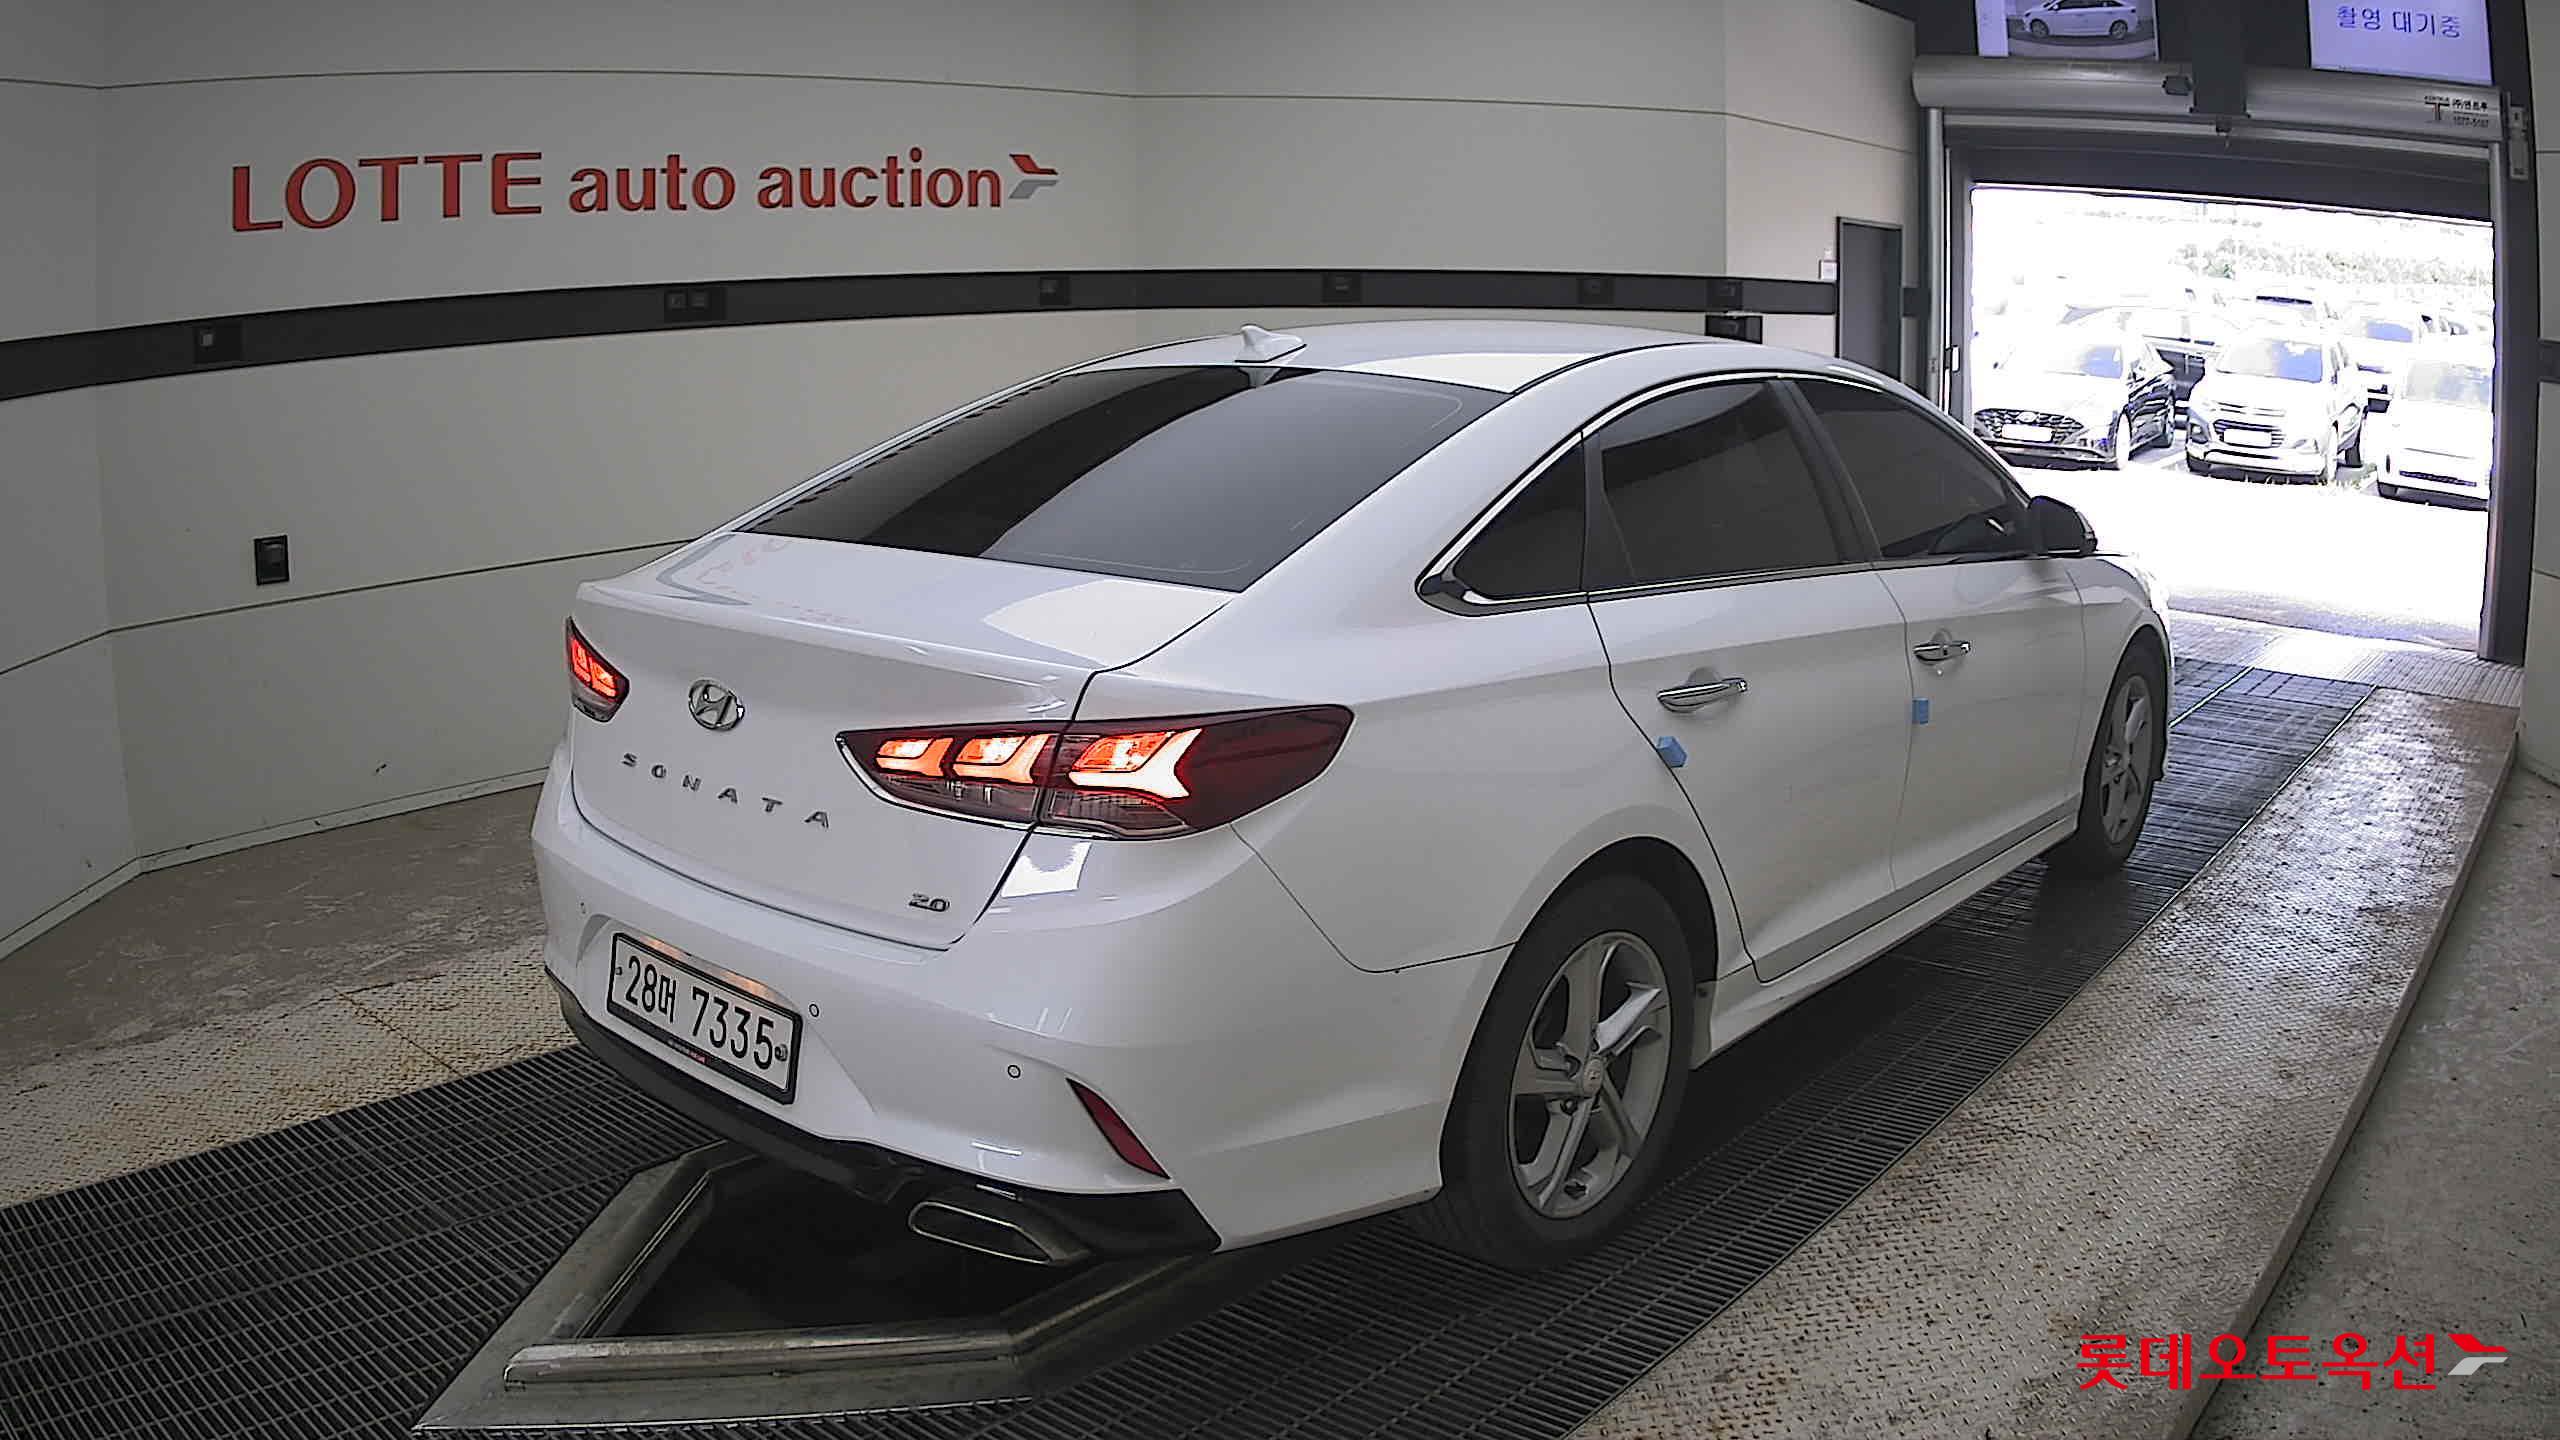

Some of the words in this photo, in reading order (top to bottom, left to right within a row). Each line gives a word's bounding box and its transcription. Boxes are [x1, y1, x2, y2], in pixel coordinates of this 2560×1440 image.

[2337, 5, 2382, 31] 촬영
[2392, 11, 2461, 39] 대기중
[231, 151, 543, 233] LOTTE
[568, 153, 736, 214] auto
[757, 146, 1003, 210] auction
[621, 751, 831, 830] SONATA
[625, 955, 677, 1024] 28머
[692, 985, 775, 1070] 7335
